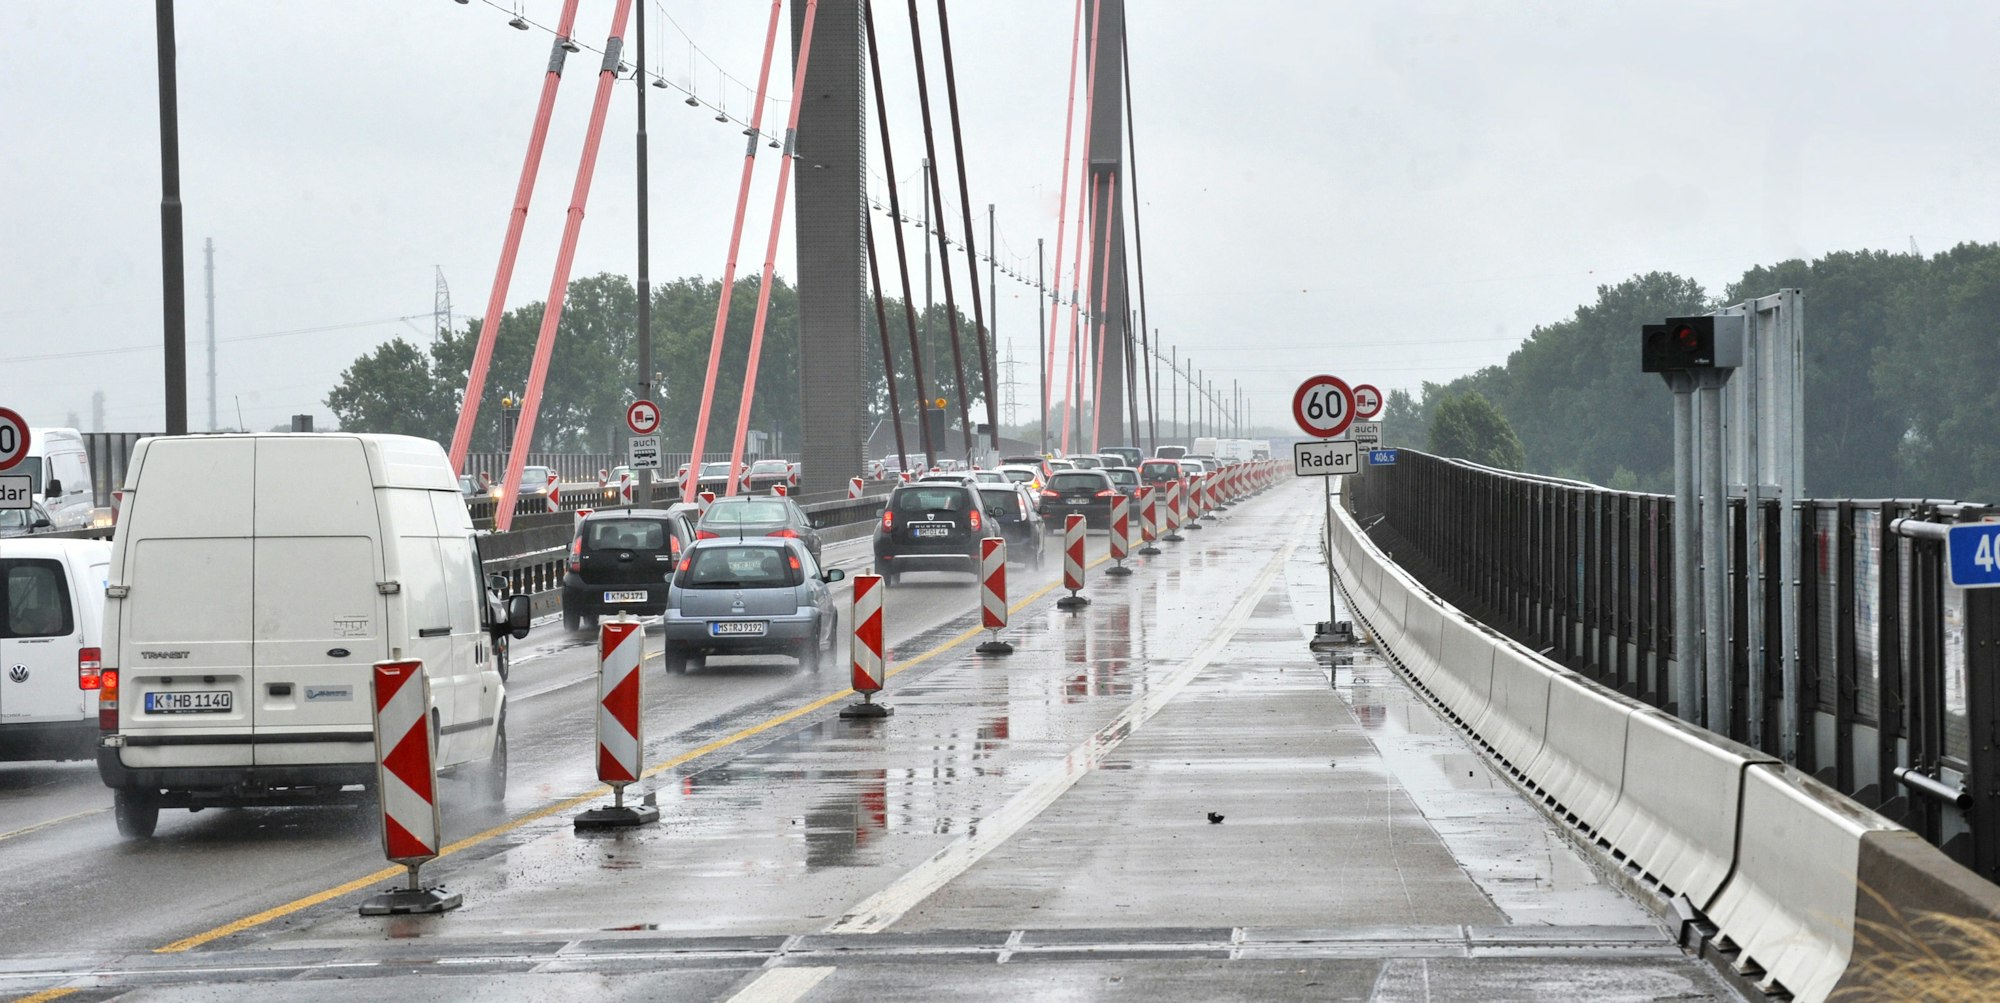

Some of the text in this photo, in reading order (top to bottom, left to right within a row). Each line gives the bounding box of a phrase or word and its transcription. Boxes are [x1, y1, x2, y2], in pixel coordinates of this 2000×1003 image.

[1307, 391, 1342, 419] 60
[1354, 424, 1378, 433] auch
[633, 438, 656, 447] auch
[1301, 450, 1353, 467] Radar
[718, 623, 762, 632] MS RJ 9192
[141, 651, 190, 659] TRANSIT
[155, 694, 229, 708] K HB 1140
